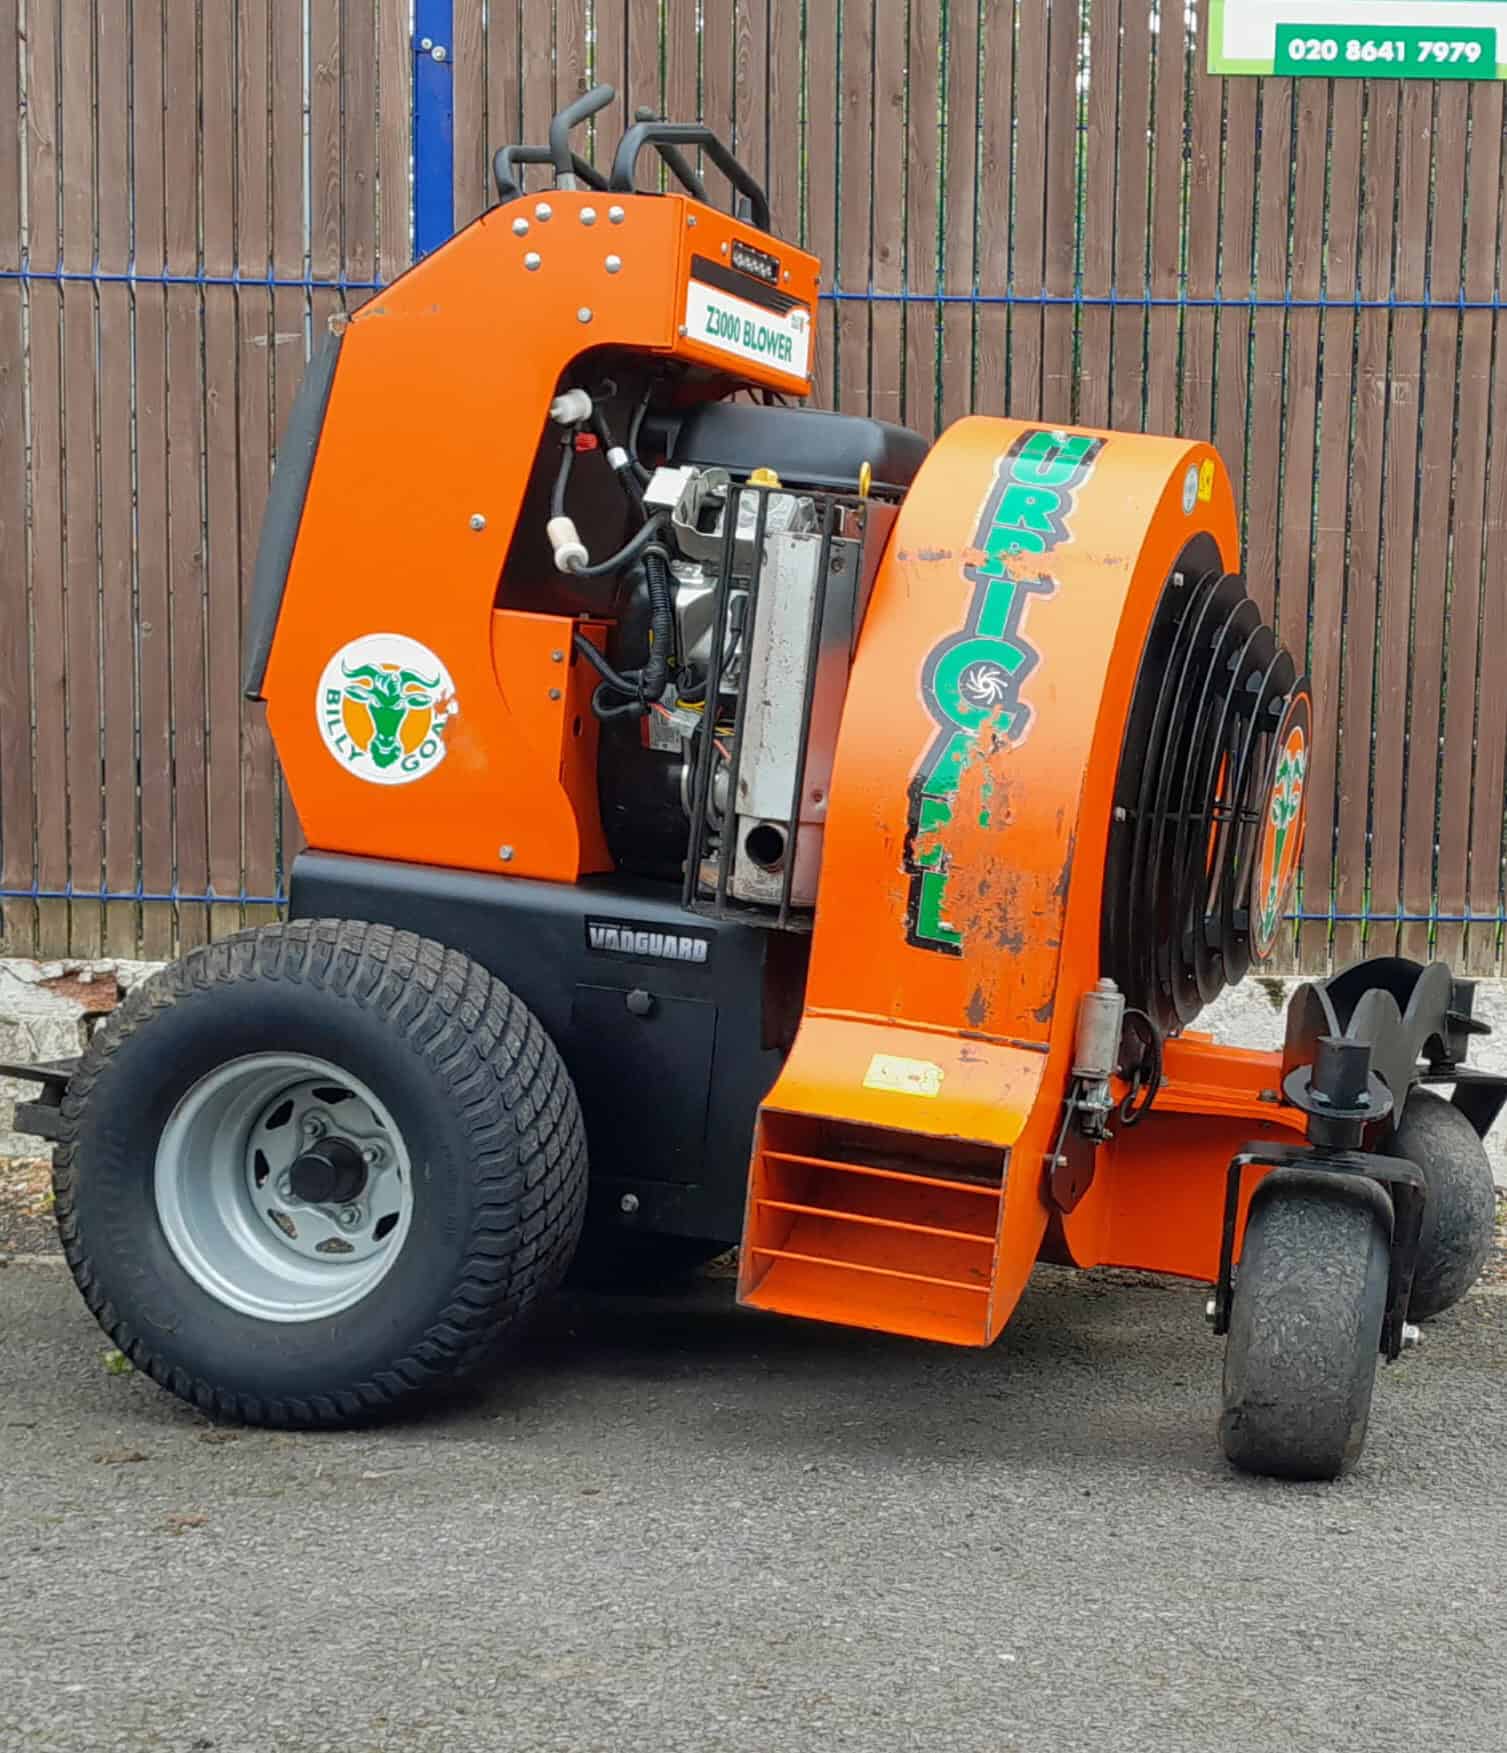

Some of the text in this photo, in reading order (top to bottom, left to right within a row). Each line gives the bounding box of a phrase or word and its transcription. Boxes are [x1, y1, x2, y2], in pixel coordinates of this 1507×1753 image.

[1287, 38, 1482, 63] 020 8641 7979
[705, 304, 793, 362] Z3000 BLOWER
[326, 688, 449, 772] BILLY GOA
[589, 927, 708, 963] VANGUARD
